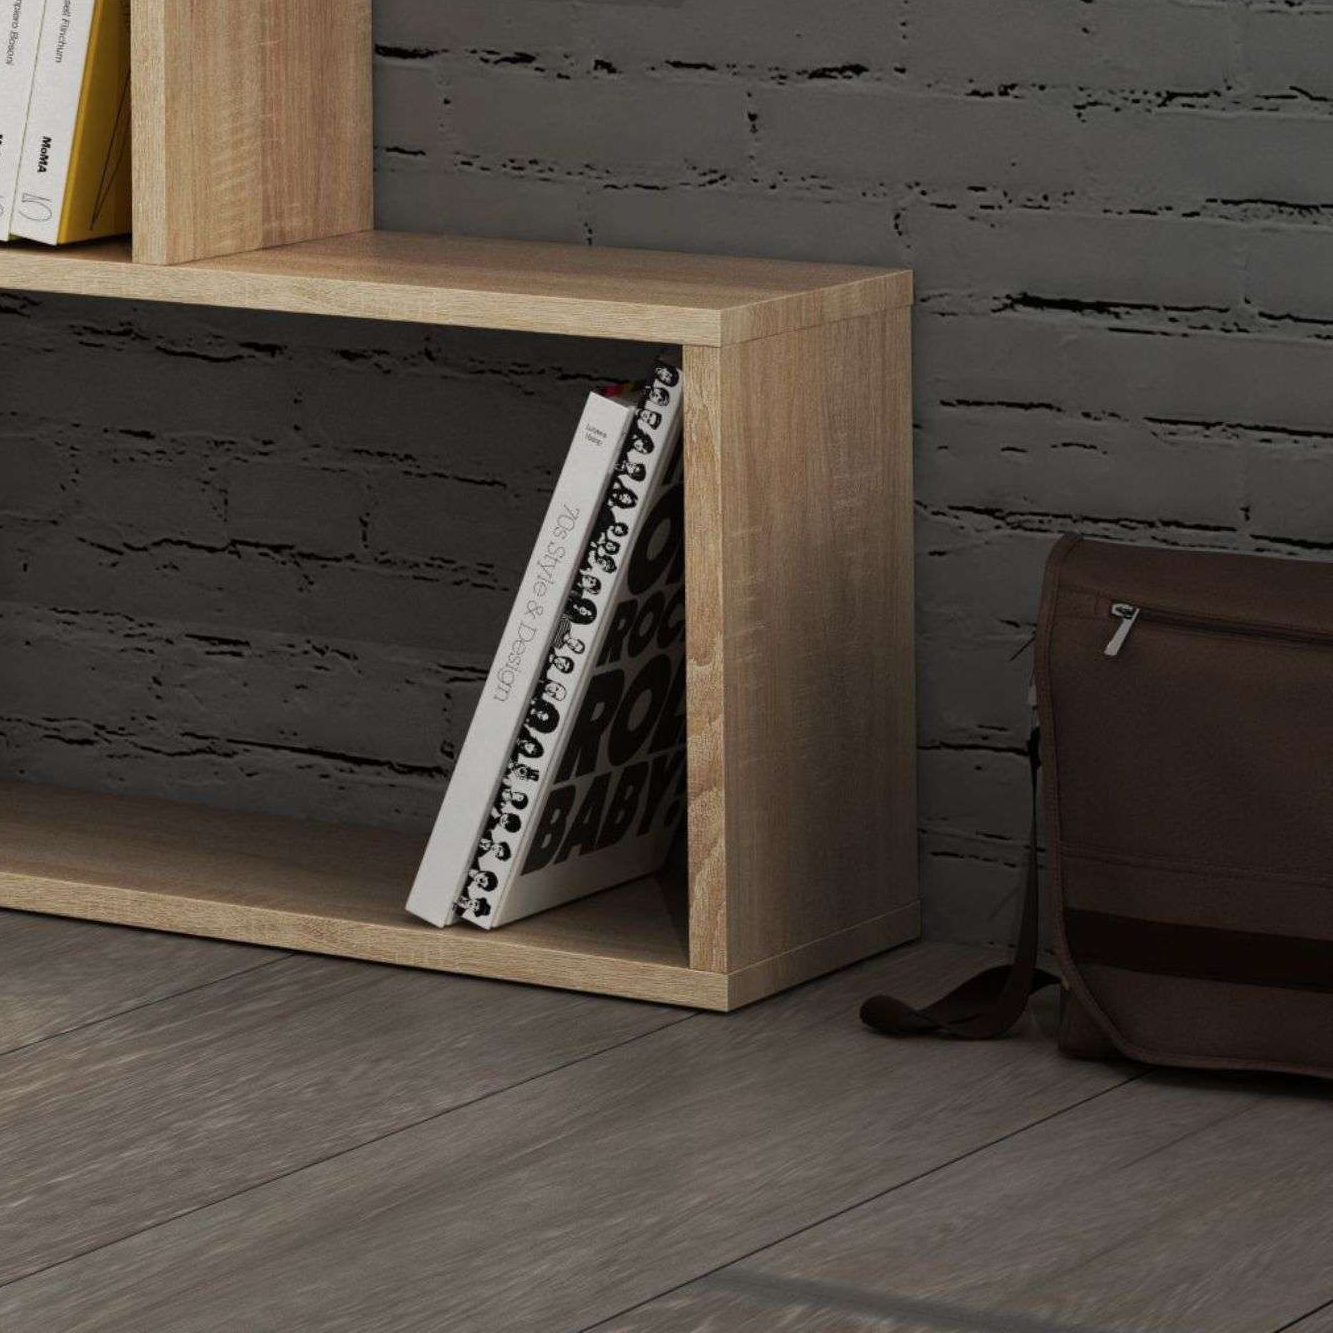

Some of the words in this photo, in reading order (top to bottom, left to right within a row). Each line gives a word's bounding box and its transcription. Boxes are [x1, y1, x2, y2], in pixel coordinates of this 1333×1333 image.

[38, 136, 52, 172] MoMA
[553, 504, 580, 540] 70s
[533, 544, 566, 599] Style
[525, 600, 543, 619] &
[493, 621, 537, 702] Design
